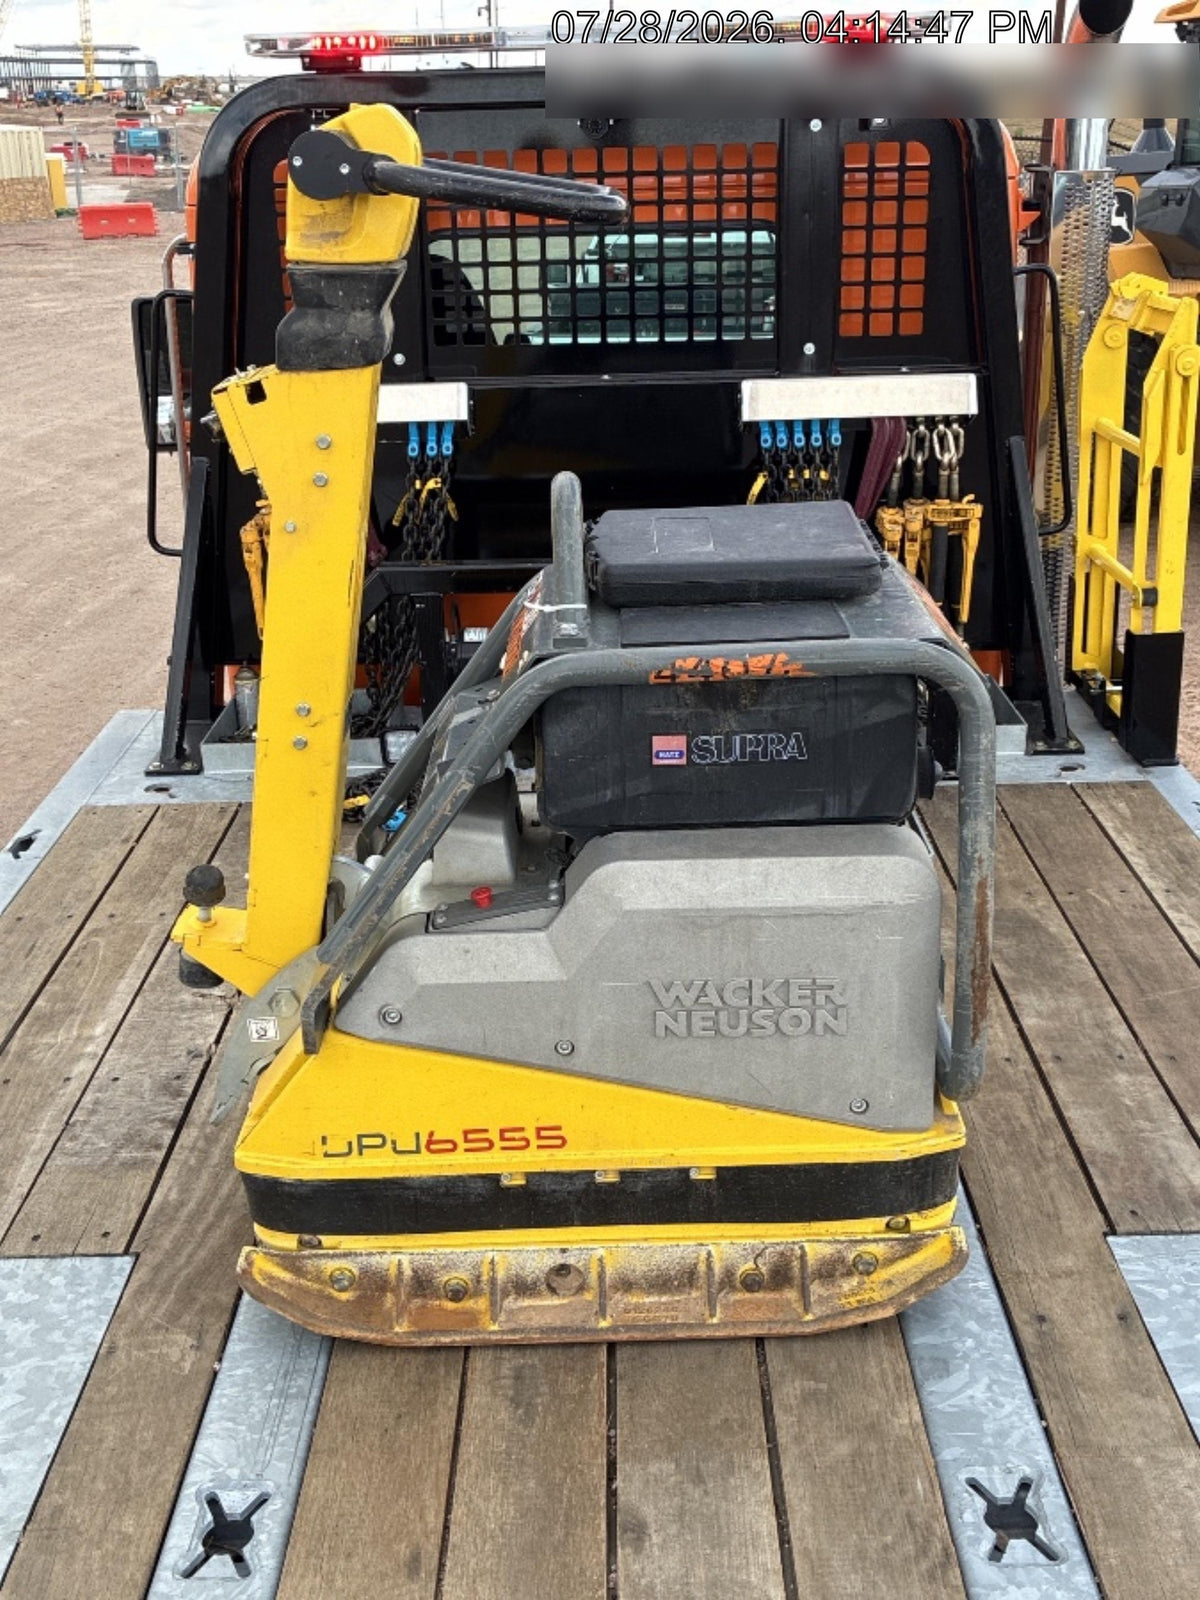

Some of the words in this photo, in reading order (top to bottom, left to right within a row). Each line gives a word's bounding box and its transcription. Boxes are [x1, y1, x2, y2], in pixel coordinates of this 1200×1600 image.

[691, 732, 808, 763] SUPRA
[648, 978, 848, 1008] WACKER
[654, 1008, 848, 1037] NEUSON
